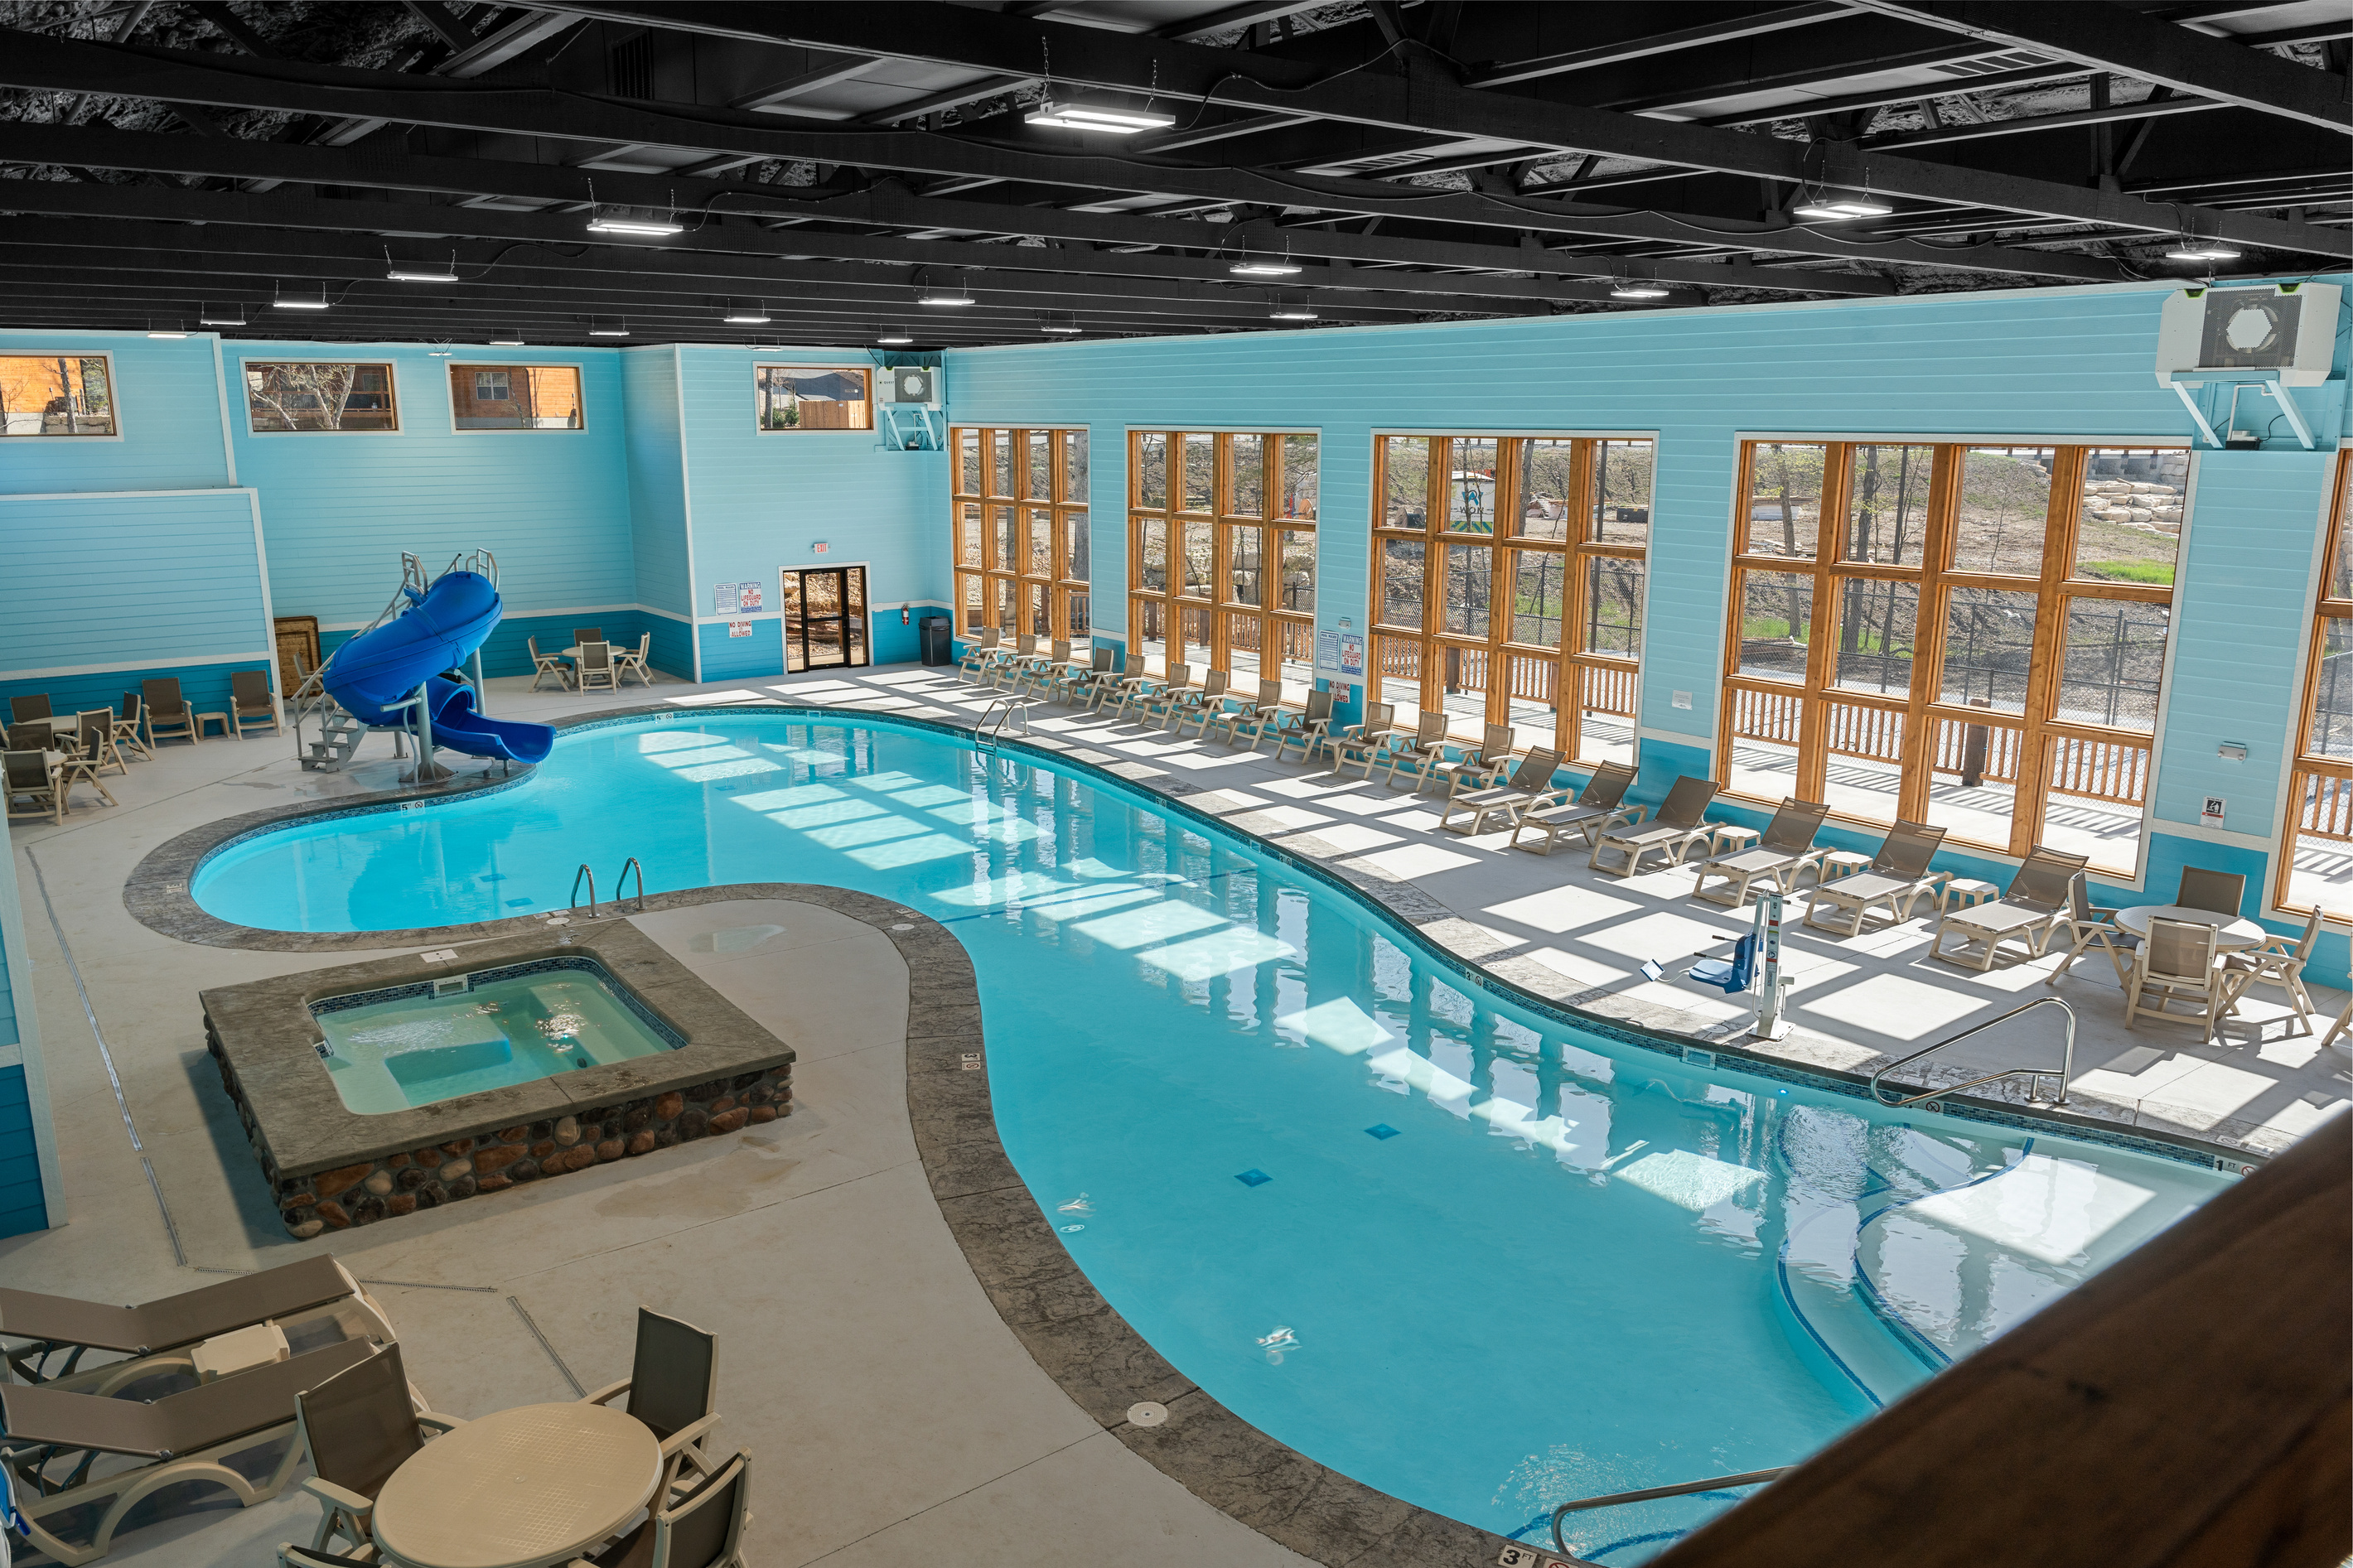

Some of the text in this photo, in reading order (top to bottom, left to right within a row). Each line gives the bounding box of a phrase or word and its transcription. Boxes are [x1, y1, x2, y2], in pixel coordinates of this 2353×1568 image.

[817, 543, 827, 552] EXIT
[1342, 634, 1362, 645] WARNING
[1342, 650, 1360, 659] LIFEGUARD
[1329, 680, 1350, 691] NO DIVING
[1332, 692, 1349, 702] LLOWED
[2216, 1160, 2224, 1171] 1
[1503, 1549, 1534, 1565] 3 FT
